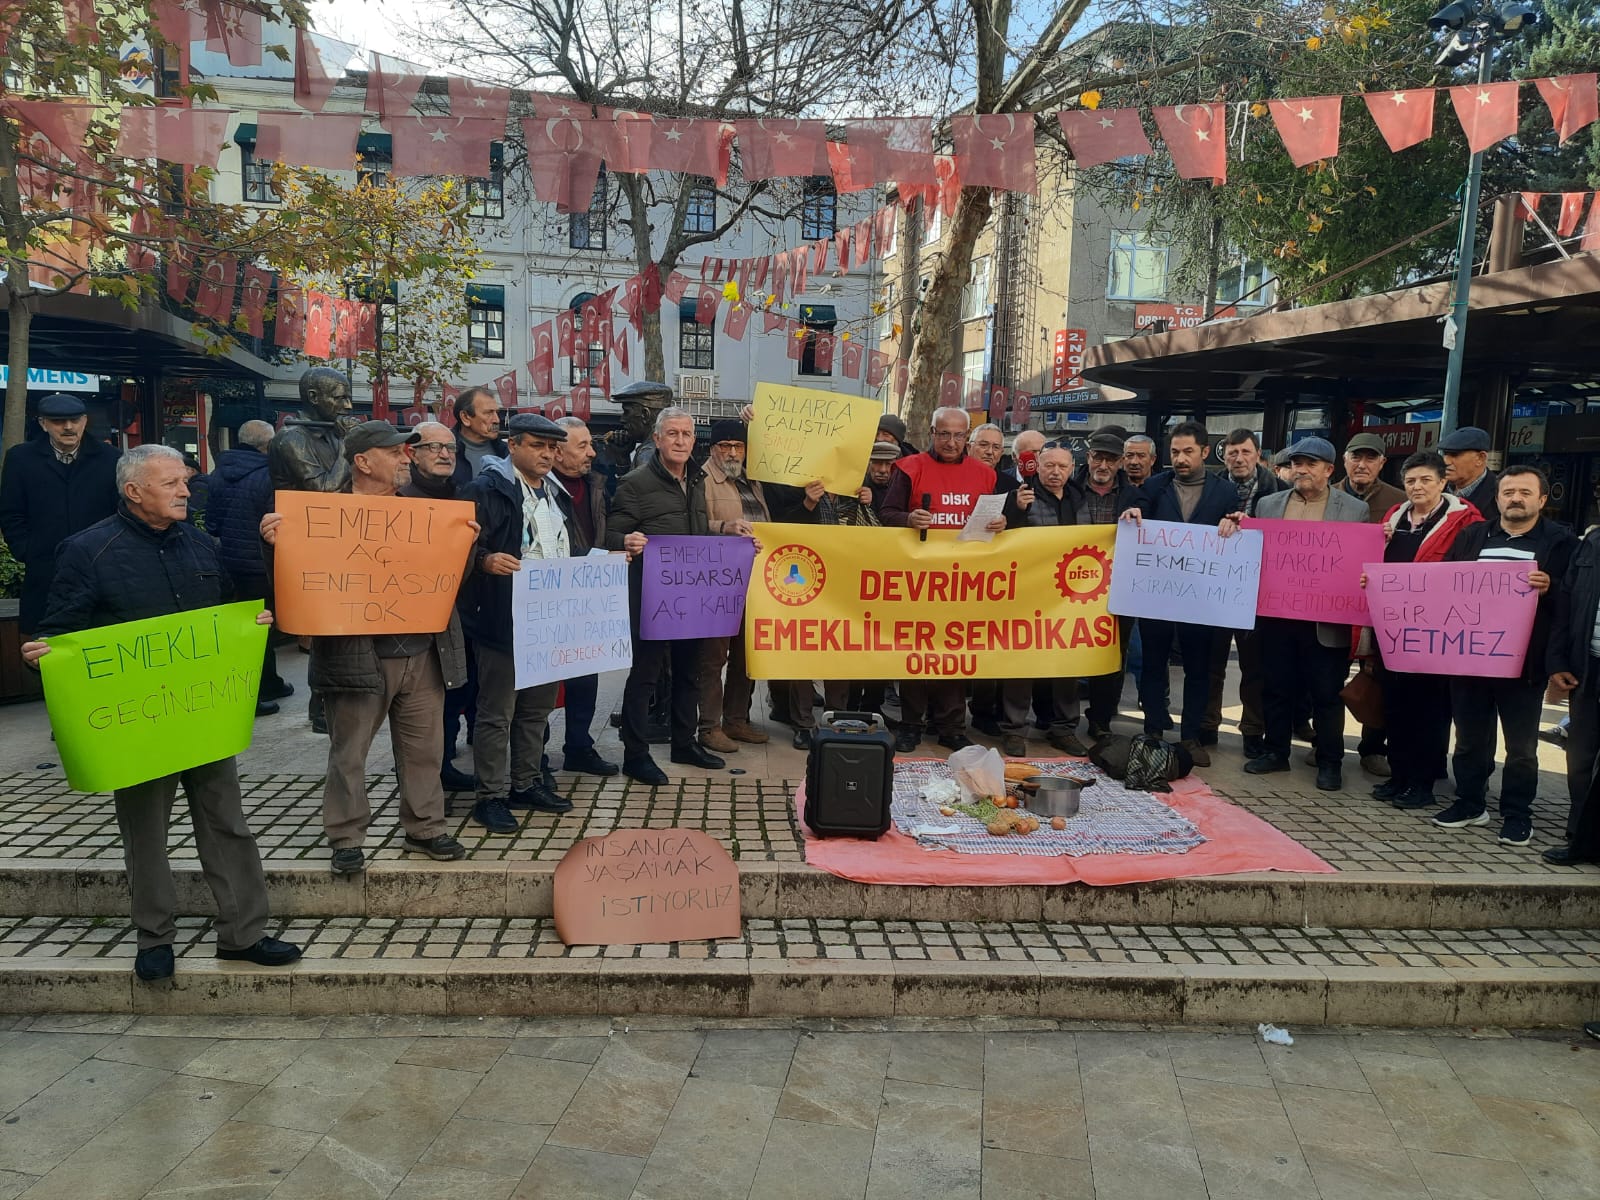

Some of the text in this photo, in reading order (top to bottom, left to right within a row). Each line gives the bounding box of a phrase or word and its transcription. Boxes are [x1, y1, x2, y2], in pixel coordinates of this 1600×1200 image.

[1174, 306, 1198, 316] T.C.
[0, 365, 89, 385] IMENS
[1067, 344, 1082, 386] NOTE
[768, 394, 852, 422] YILLARCA
[764, 414, 845, 437] ÇALIŞTIK
[1400, 428, 1415, 446] EVİ
[1510, 425, 1533, 448] afe
[941, 492, 971, 506] DİSK
[305, 505, 436, 545] EMEKLİ
[659, 542, 724, 564] EMEKLİ
[1263, 530, 1343, 553] TORUNA
[1069, 565, 1100, 580] DİSK
[1135, 552, 1219, 577] EKMEYE
[528, 563, 562, 591] EVİN
[660, 567, 744, 587] SUSARSA
[859, 561, 1018, 602] DEVRİMCİ
[1381, 571, 1427, 593] BU
[600, 594, 619, 614] VE
[651, 596, 689, 622] AÇ
[1258, 589, 1370, 613] VEREMİYORU
[1382, 601, 1482, 626] BİR AY
[754, 609, 1118, 652] EMEKLİLER SENDİKASI
[81, 613, 221, 680] EMEKLİ
[905, 652, 978, 676] ORDU
[87, 667, 262, 731] GEÇİNEMİYO
